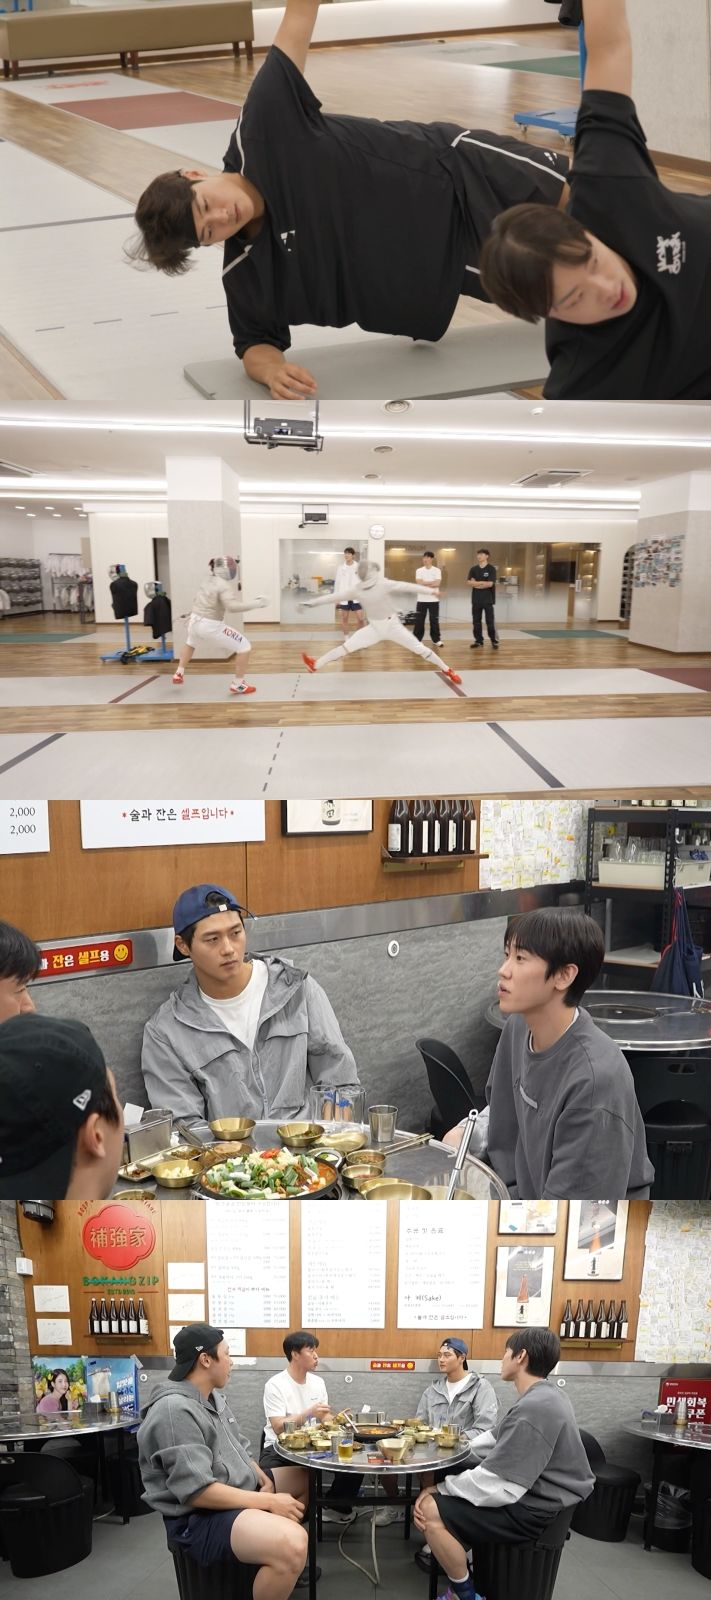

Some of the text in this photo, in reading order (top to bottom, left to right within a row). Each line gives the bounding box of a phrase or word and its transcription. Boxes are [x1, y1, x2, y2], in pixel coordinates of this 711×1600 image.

[223, 627, 243, 642] KOREA
[9, 807, 36, 818] 2,000
[129, 807, 228, 821] 술과 잔은 셀프입니다
[9, 825, 37, 835] 2,000
[52, 954, 75, 969] 잔은
[78, 949, 110, 965] 셀프용
[90, 1226, 147, 1248] 補強家
